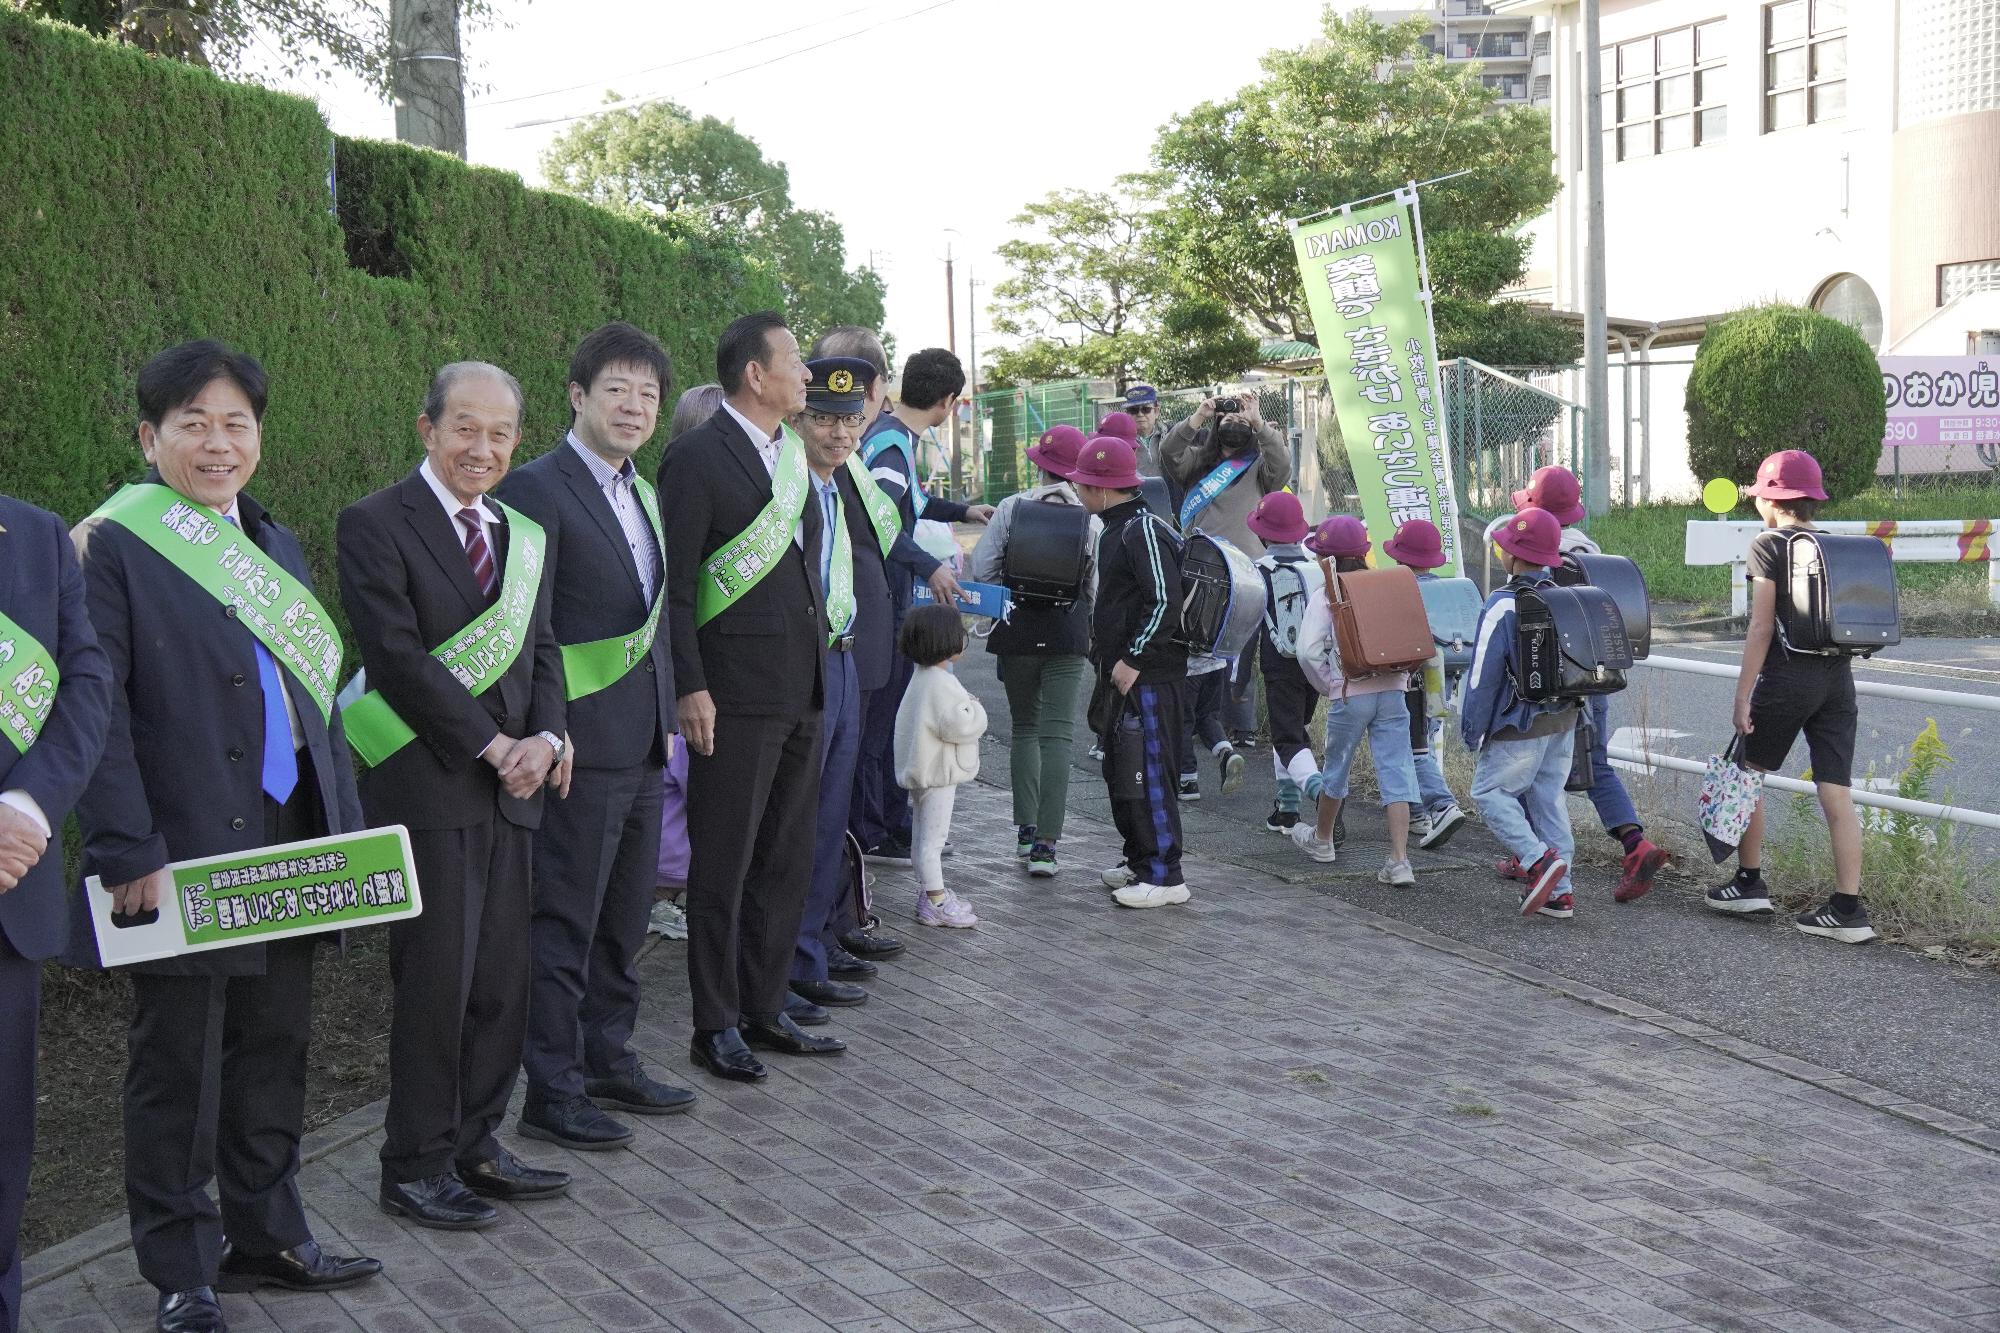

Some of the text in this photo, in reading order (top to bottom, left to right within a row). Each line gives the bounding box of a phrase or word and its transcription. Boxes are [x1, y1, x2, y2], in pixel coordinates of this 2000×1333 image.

[1976, 417, 2000, 428] 9:30
[160, 500, 220, 545] 笑顔で
[217, 541, 282, 608] さきがけ
[732, 517, 790, 583] あいさつ運動
[215, 870, 407, 930] 笑顔で さきがけ あいさつ運動
